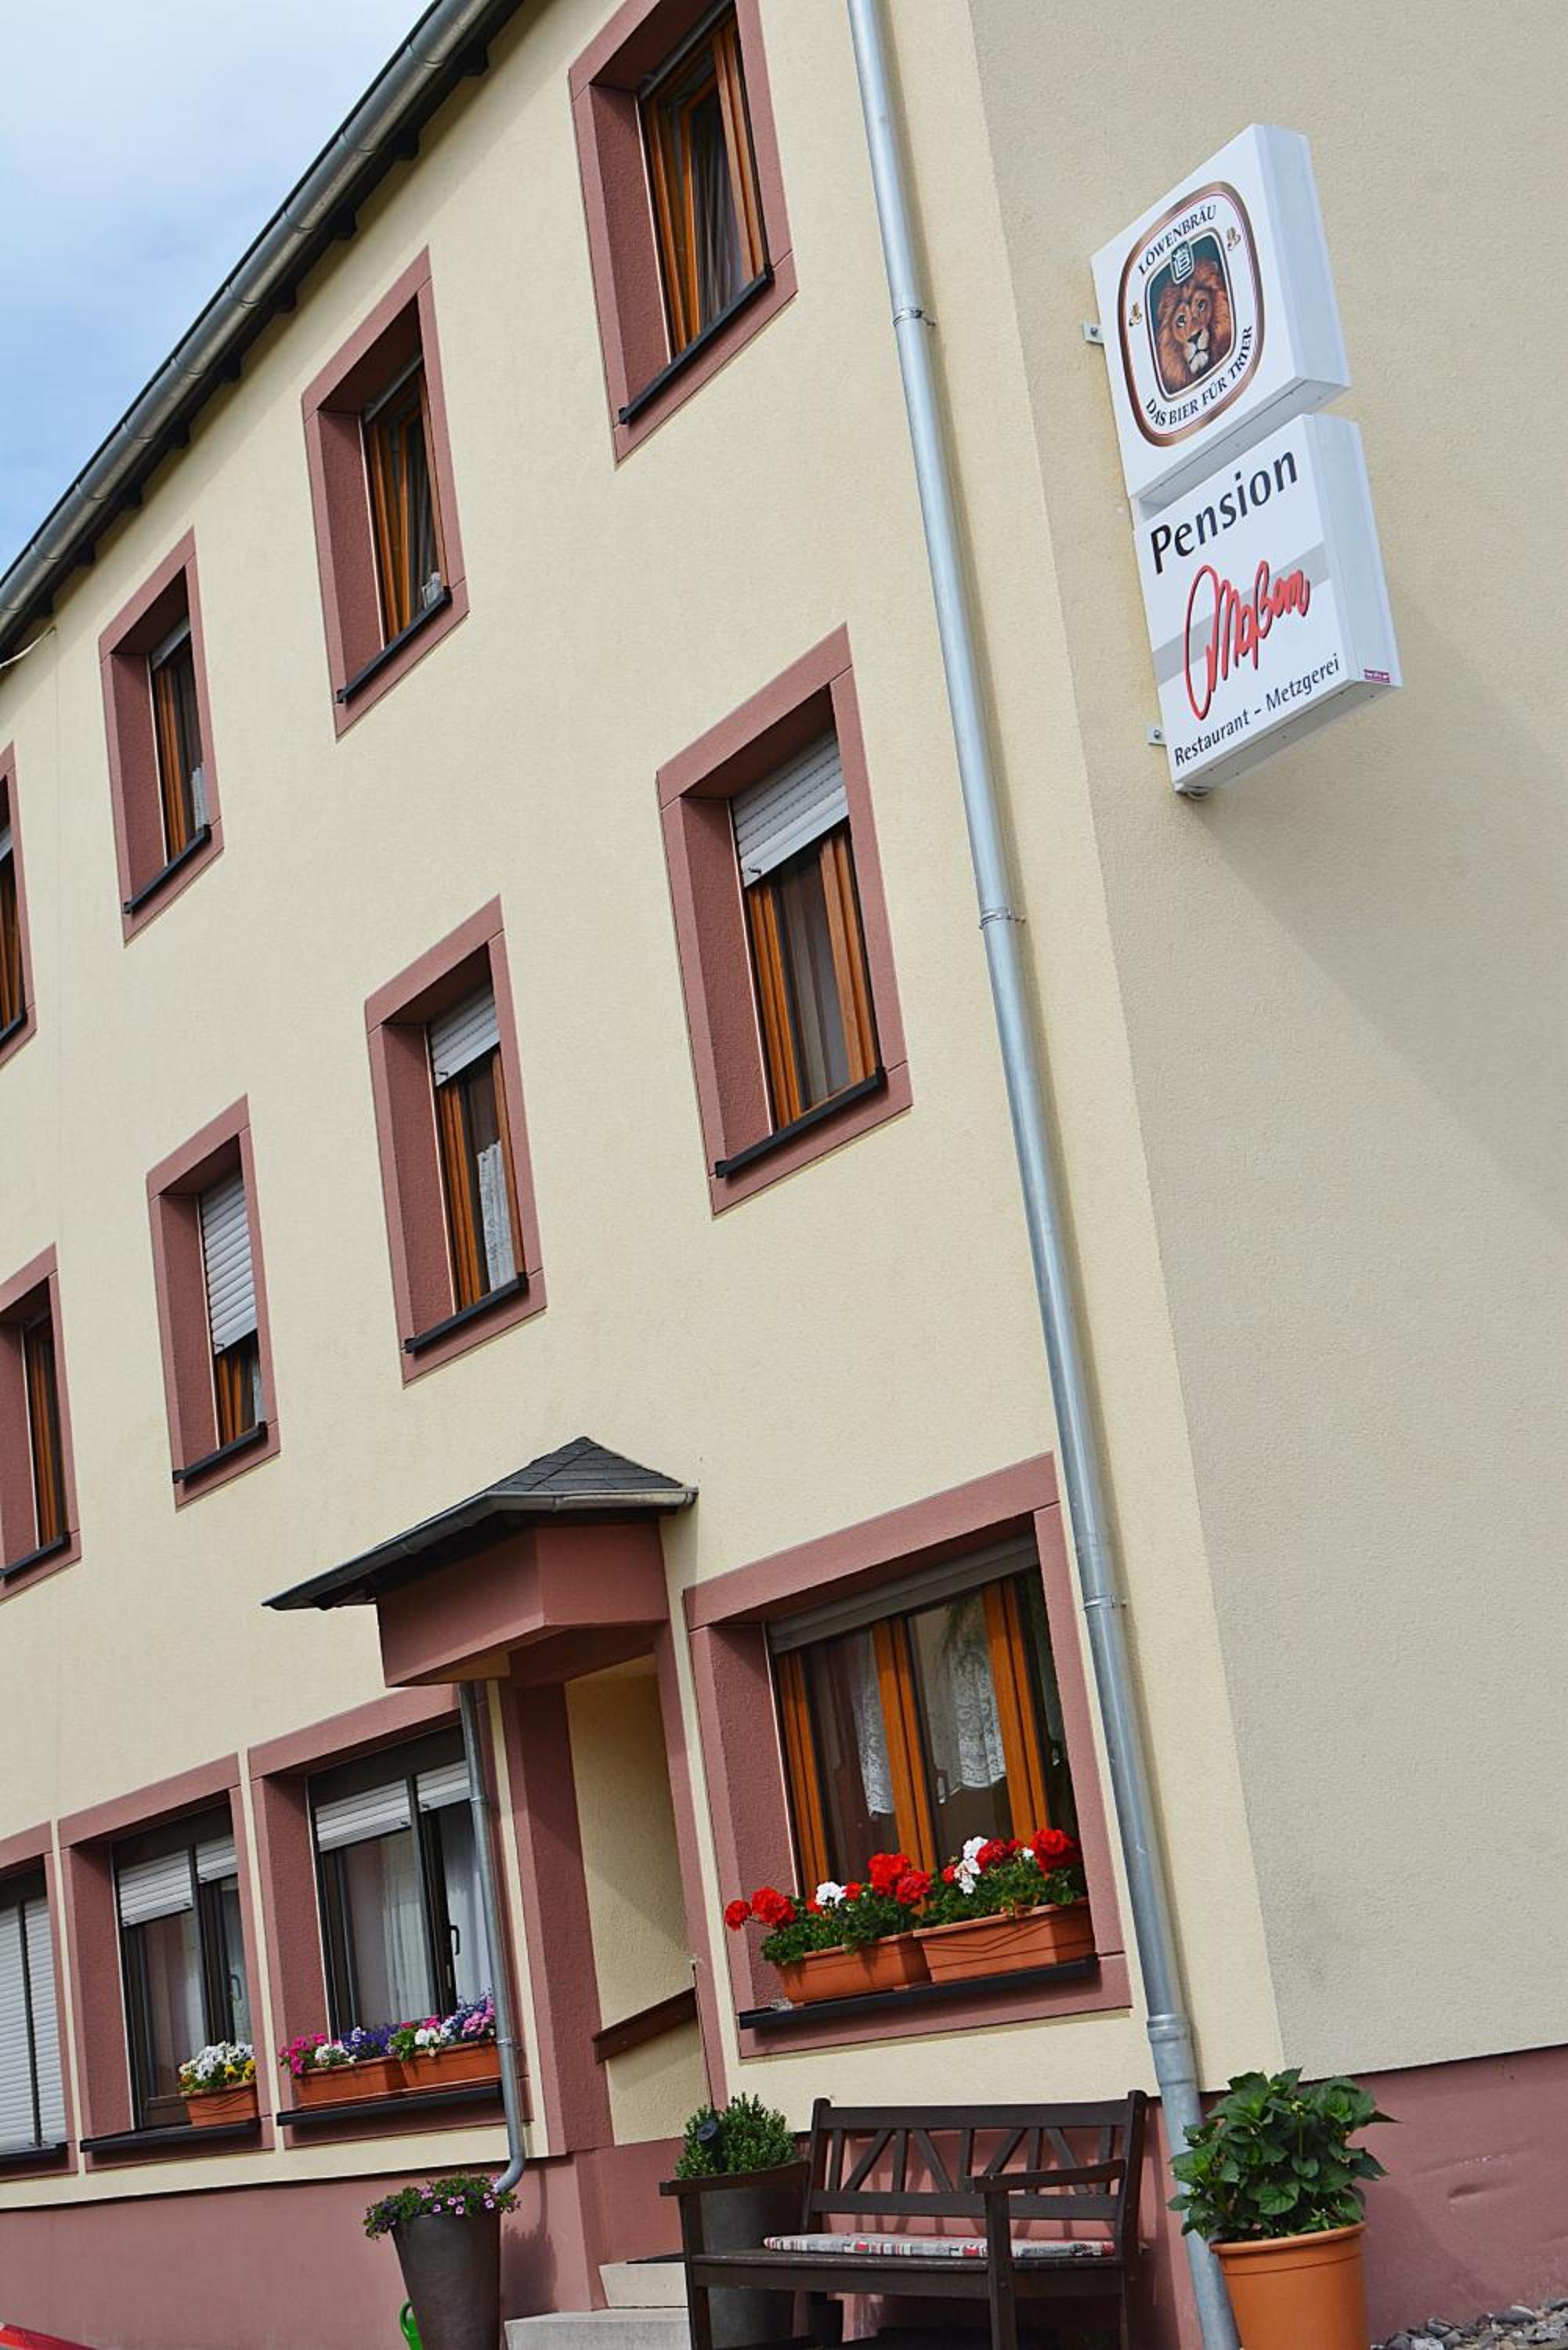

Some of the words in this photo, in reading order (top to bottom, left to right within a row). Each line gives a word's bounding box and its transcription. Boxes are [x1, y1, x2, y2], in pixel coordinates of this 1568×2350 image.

[1137, 204, 1218, 276] LÖWENBRÄU
[1146, 396, 1167, 427] DAS
[1168, 400, 1199, 426] BIER
[1201, 380, 1228, 406] FÜR
[1228, 325, 1253, 380] TRIER
[1151, 450, 1299, 575] Pension
[1174, 708, 1249, 767] Restaurant
[1266, 653, 1341, 710] Metzgerei
